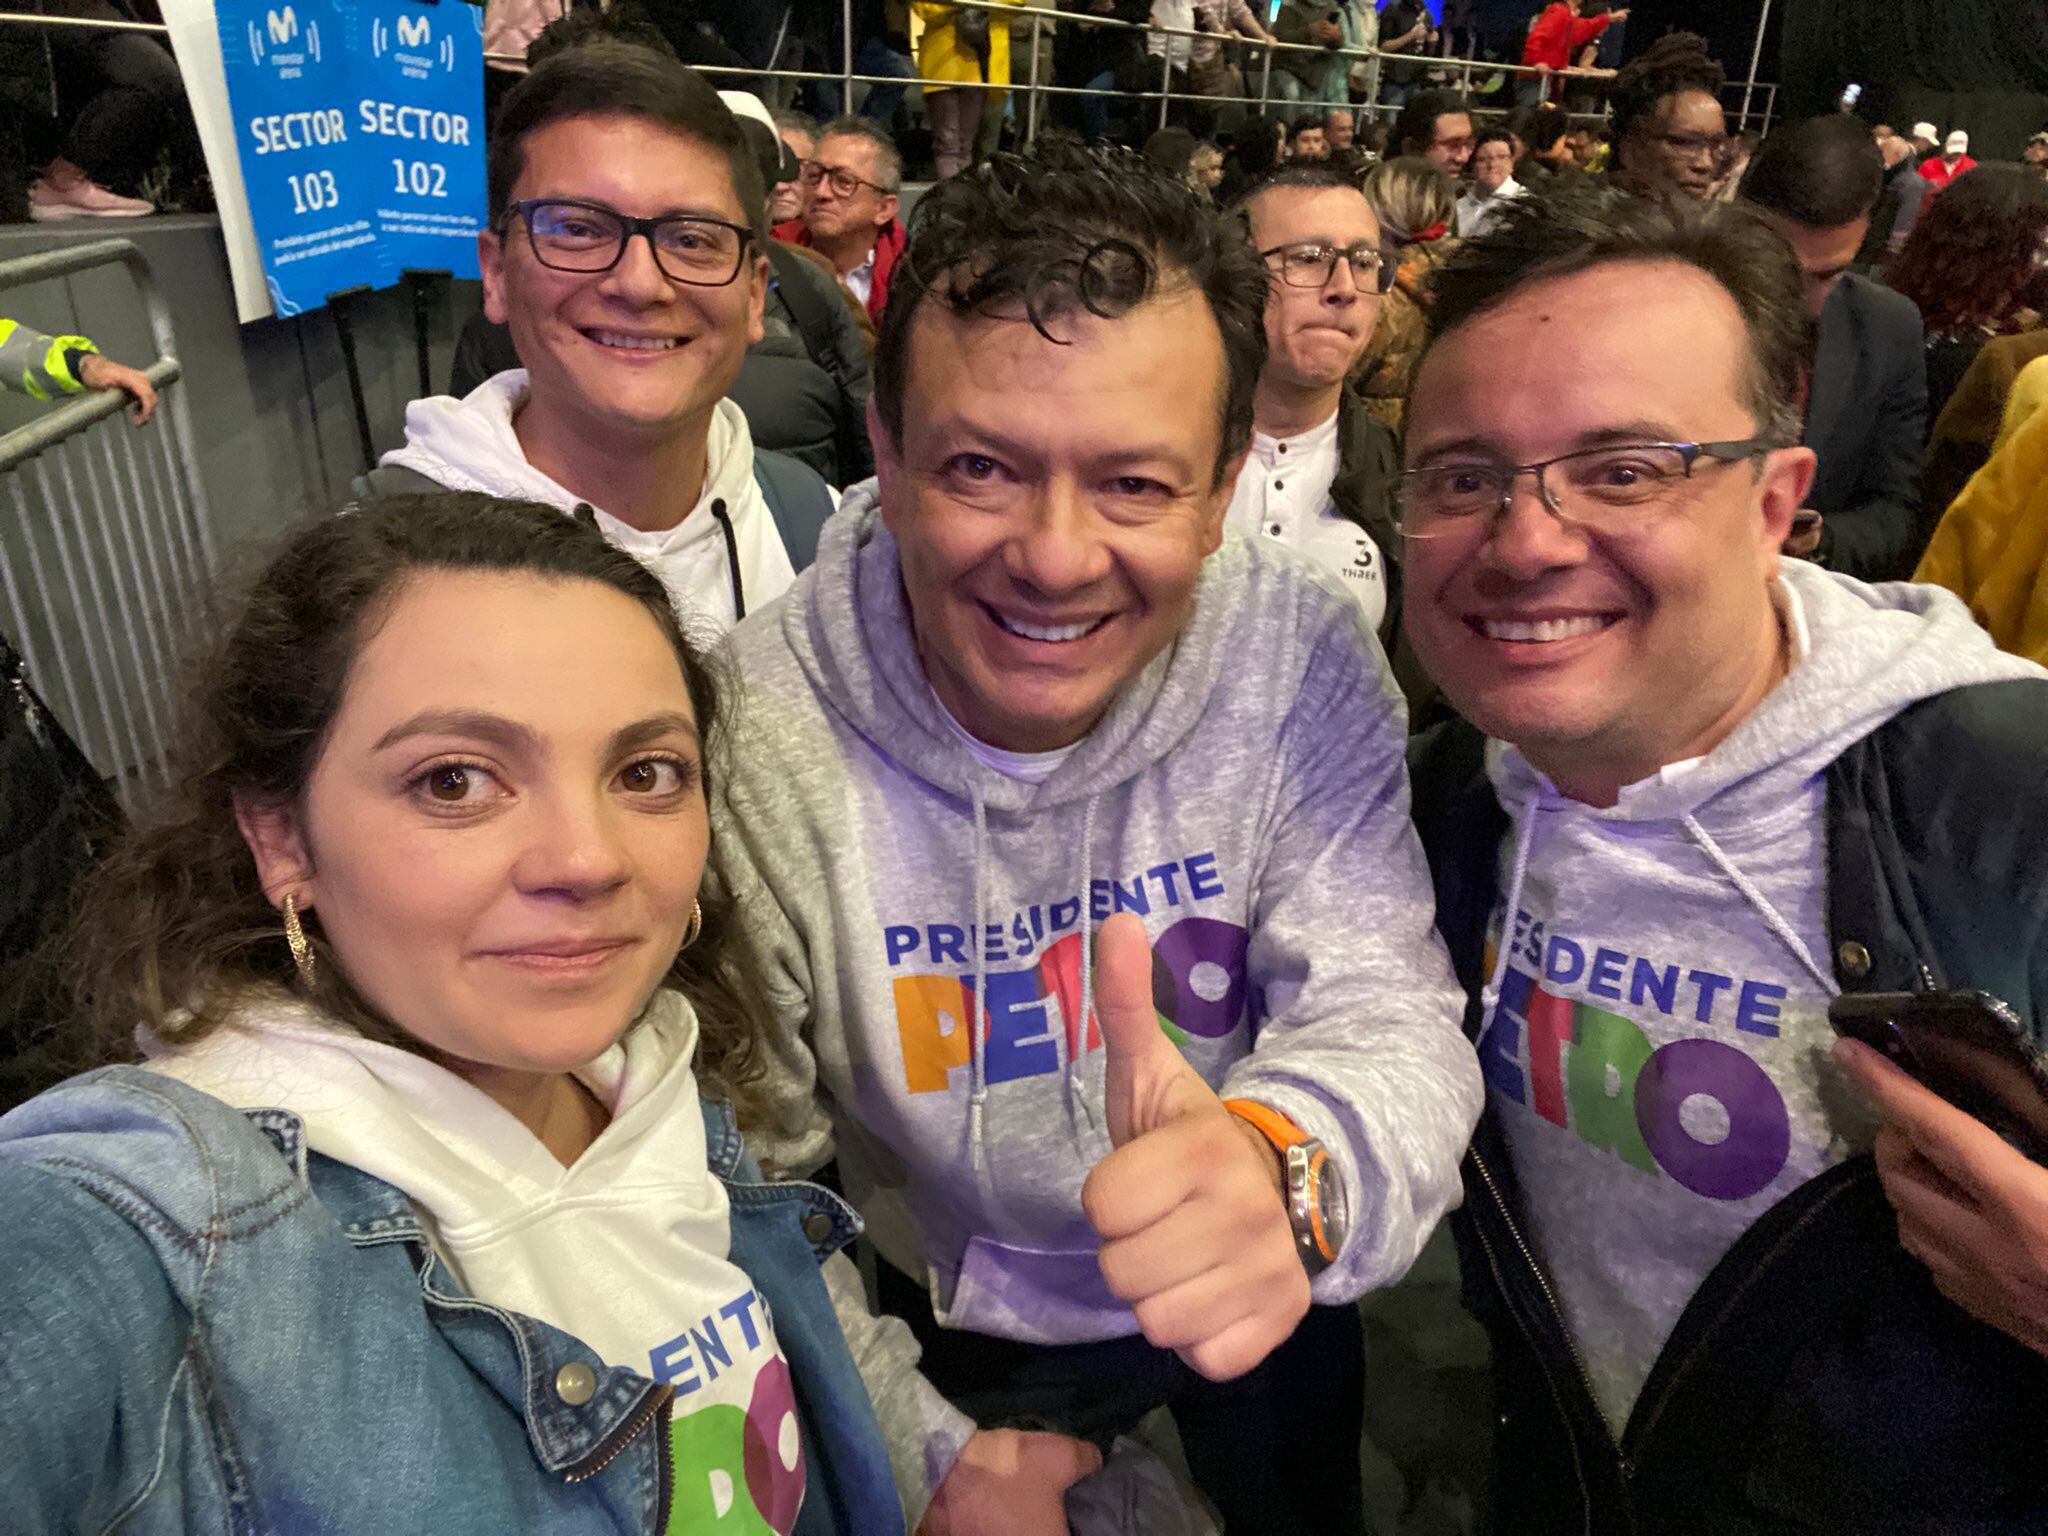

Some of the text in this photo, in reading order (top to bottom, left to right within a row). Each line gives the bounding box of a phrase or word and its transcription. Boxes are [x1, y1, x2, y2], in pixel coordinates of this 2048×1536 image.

[251, 109, 347, 154] SECTOR
[359, 99, 470, 146] SECTOR
[288, 170, 339, 214] 103
[392, 159, 448, 198] 102
[1342, 568, 1377, 581] THREE
[884, 852, 1225, 966] PRESIDENTE
